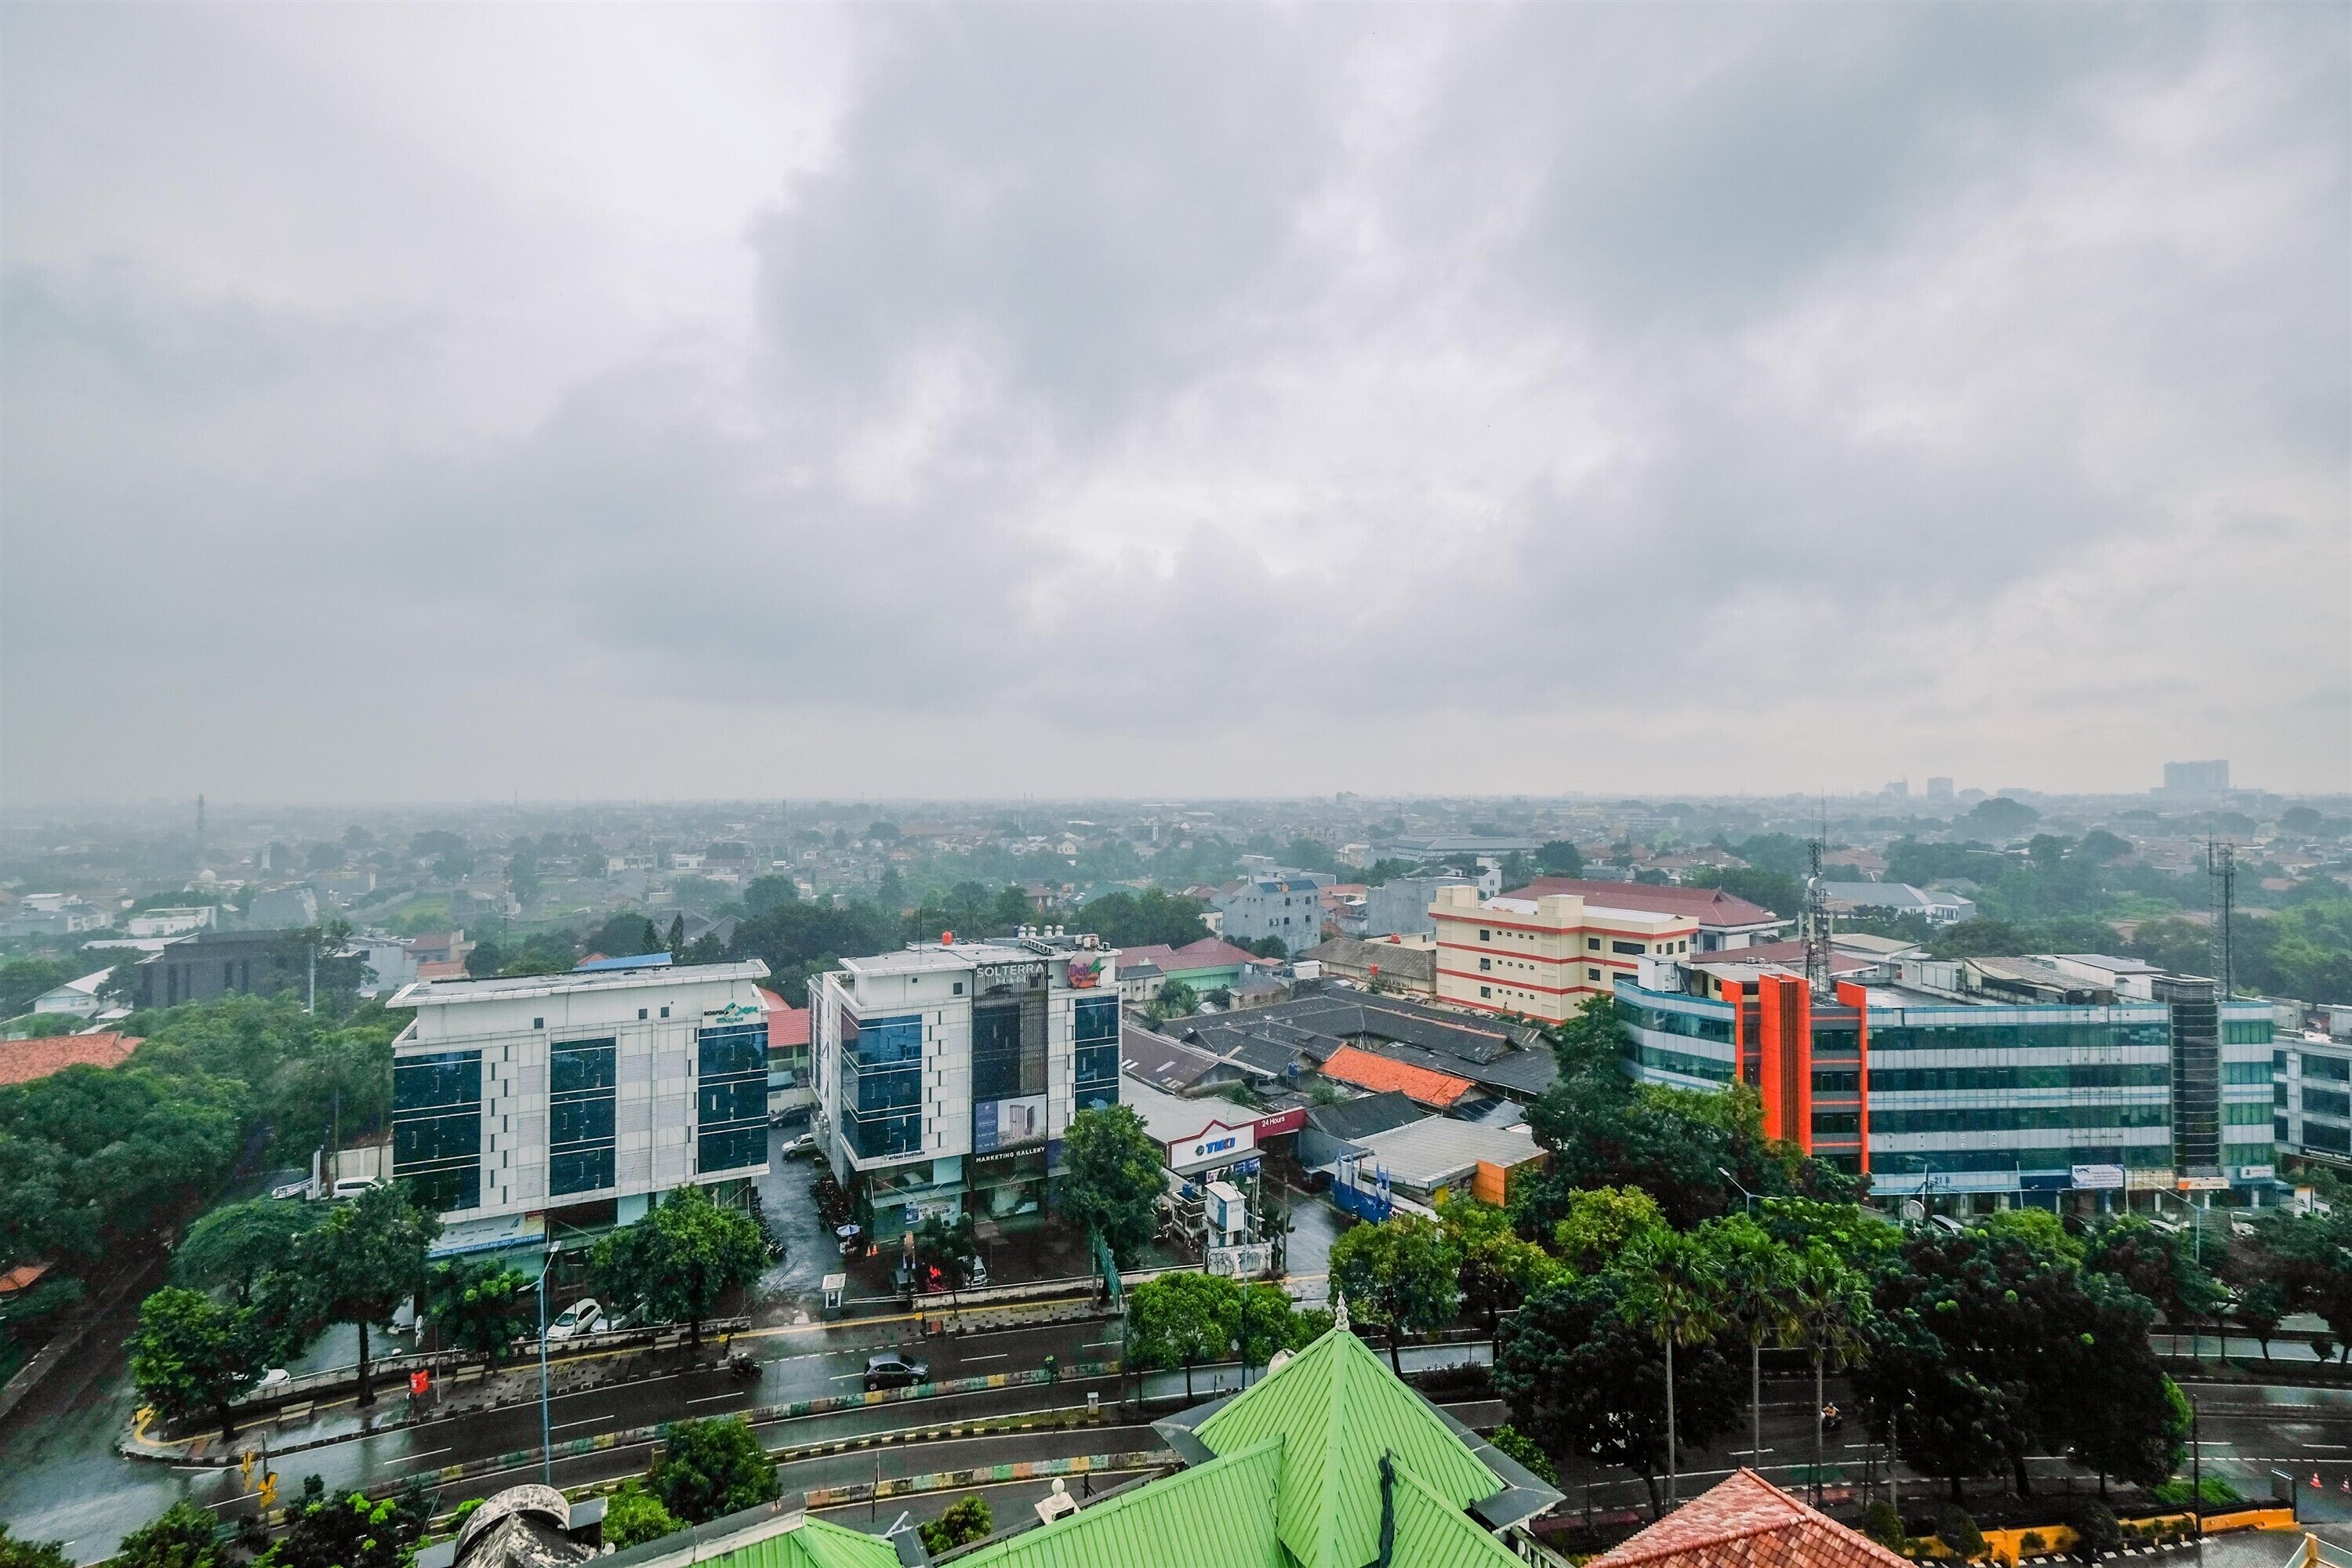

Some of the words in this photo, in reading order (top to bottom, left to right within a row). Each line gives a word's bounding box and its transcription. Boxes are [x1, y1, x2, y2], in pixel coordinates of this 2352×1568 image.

[976, 963, 1044, 977] SOLTERRA
[1261, 1119, 1269, 1127] 24
[1269, 1116, 1286, 1125] Hours
[976, 1152, 1014, 1163] MARKETING
[1016, 1146, 1046, 1156] GALLERY
